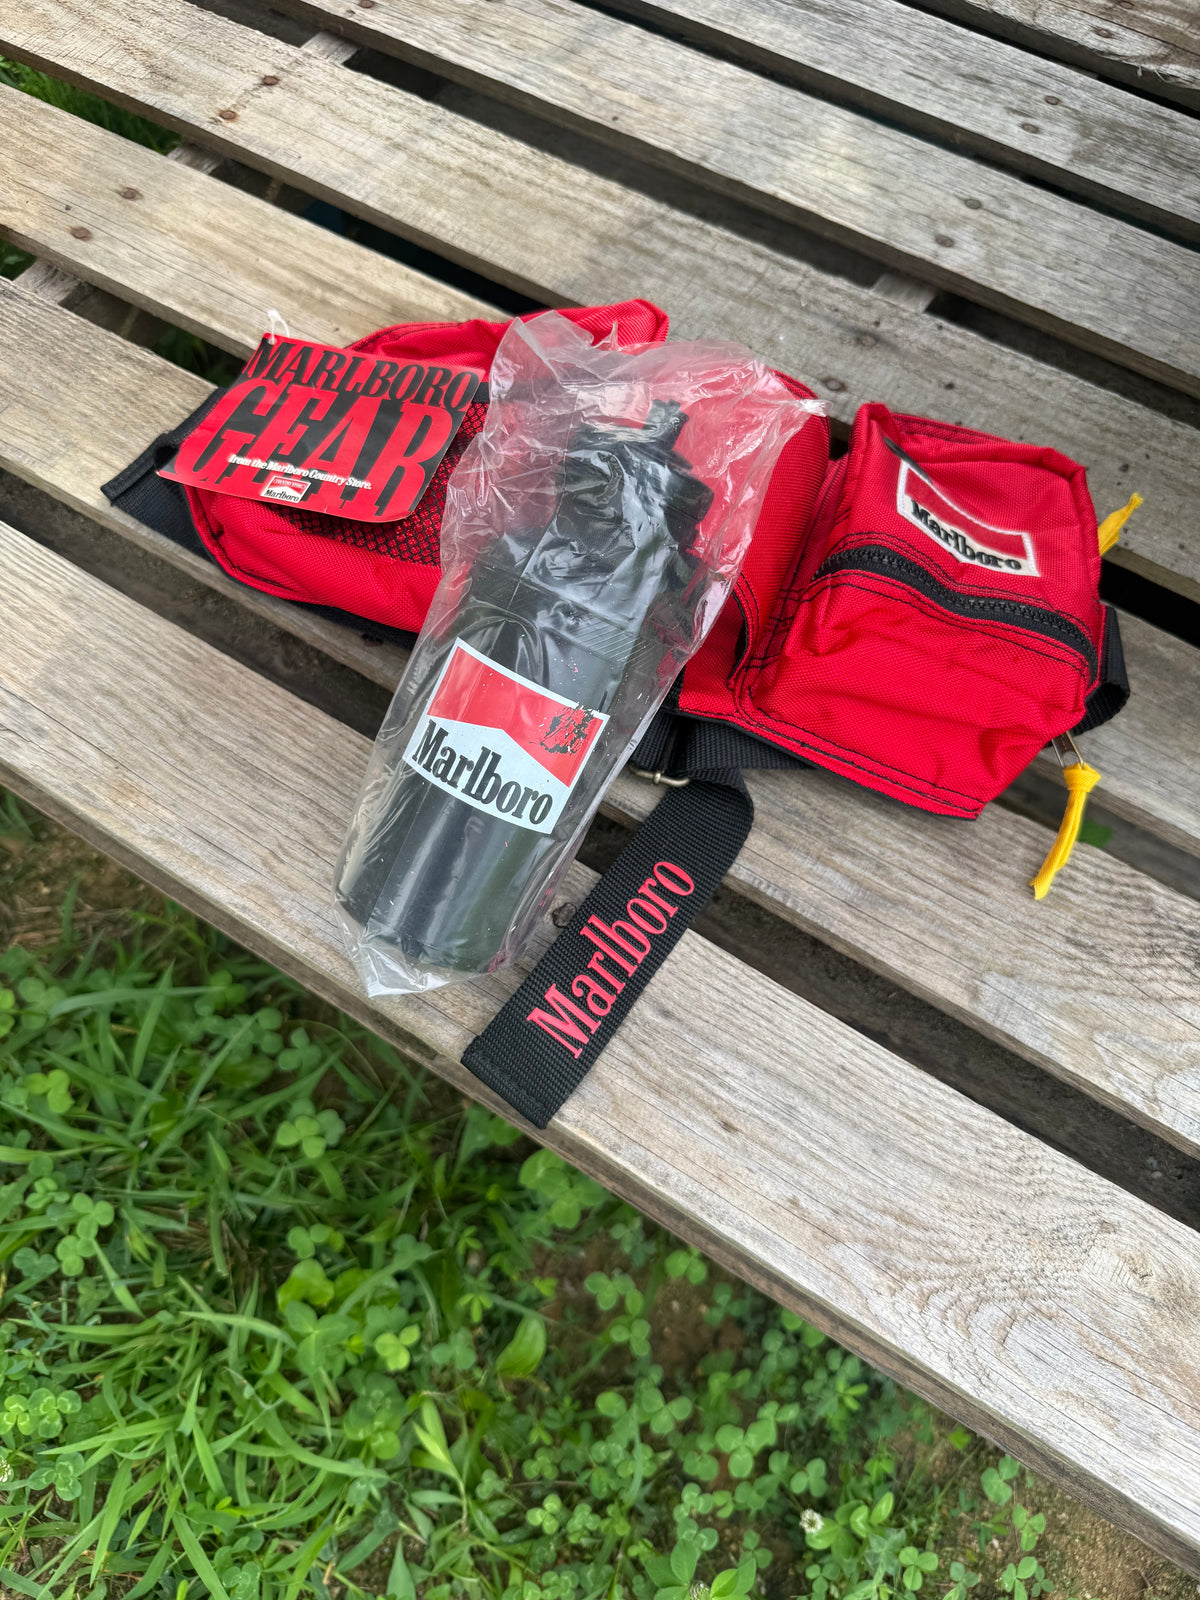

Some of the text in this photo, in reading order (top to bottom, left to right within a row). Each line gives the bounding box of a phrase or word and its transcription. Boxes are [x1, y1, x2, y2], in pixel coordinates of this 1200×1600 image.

[242, 337, 481, 411] MARLBORO
[174, 377, 454, 517] GEAR
[229, 454, 252, 466] from
[251, 459, 268, 469] the
[266, 461, 309, 477] Marlboro
[309, 469, 346, 486] Country
[345, 477, 372, 490] Store.
[264, 489, 300, 502] Marlboro
[911, 499, 1022, 571] Marlboro
[411, 718, 553, 825] Marlboro
[526, 861, 695, 1059] Marlboro
